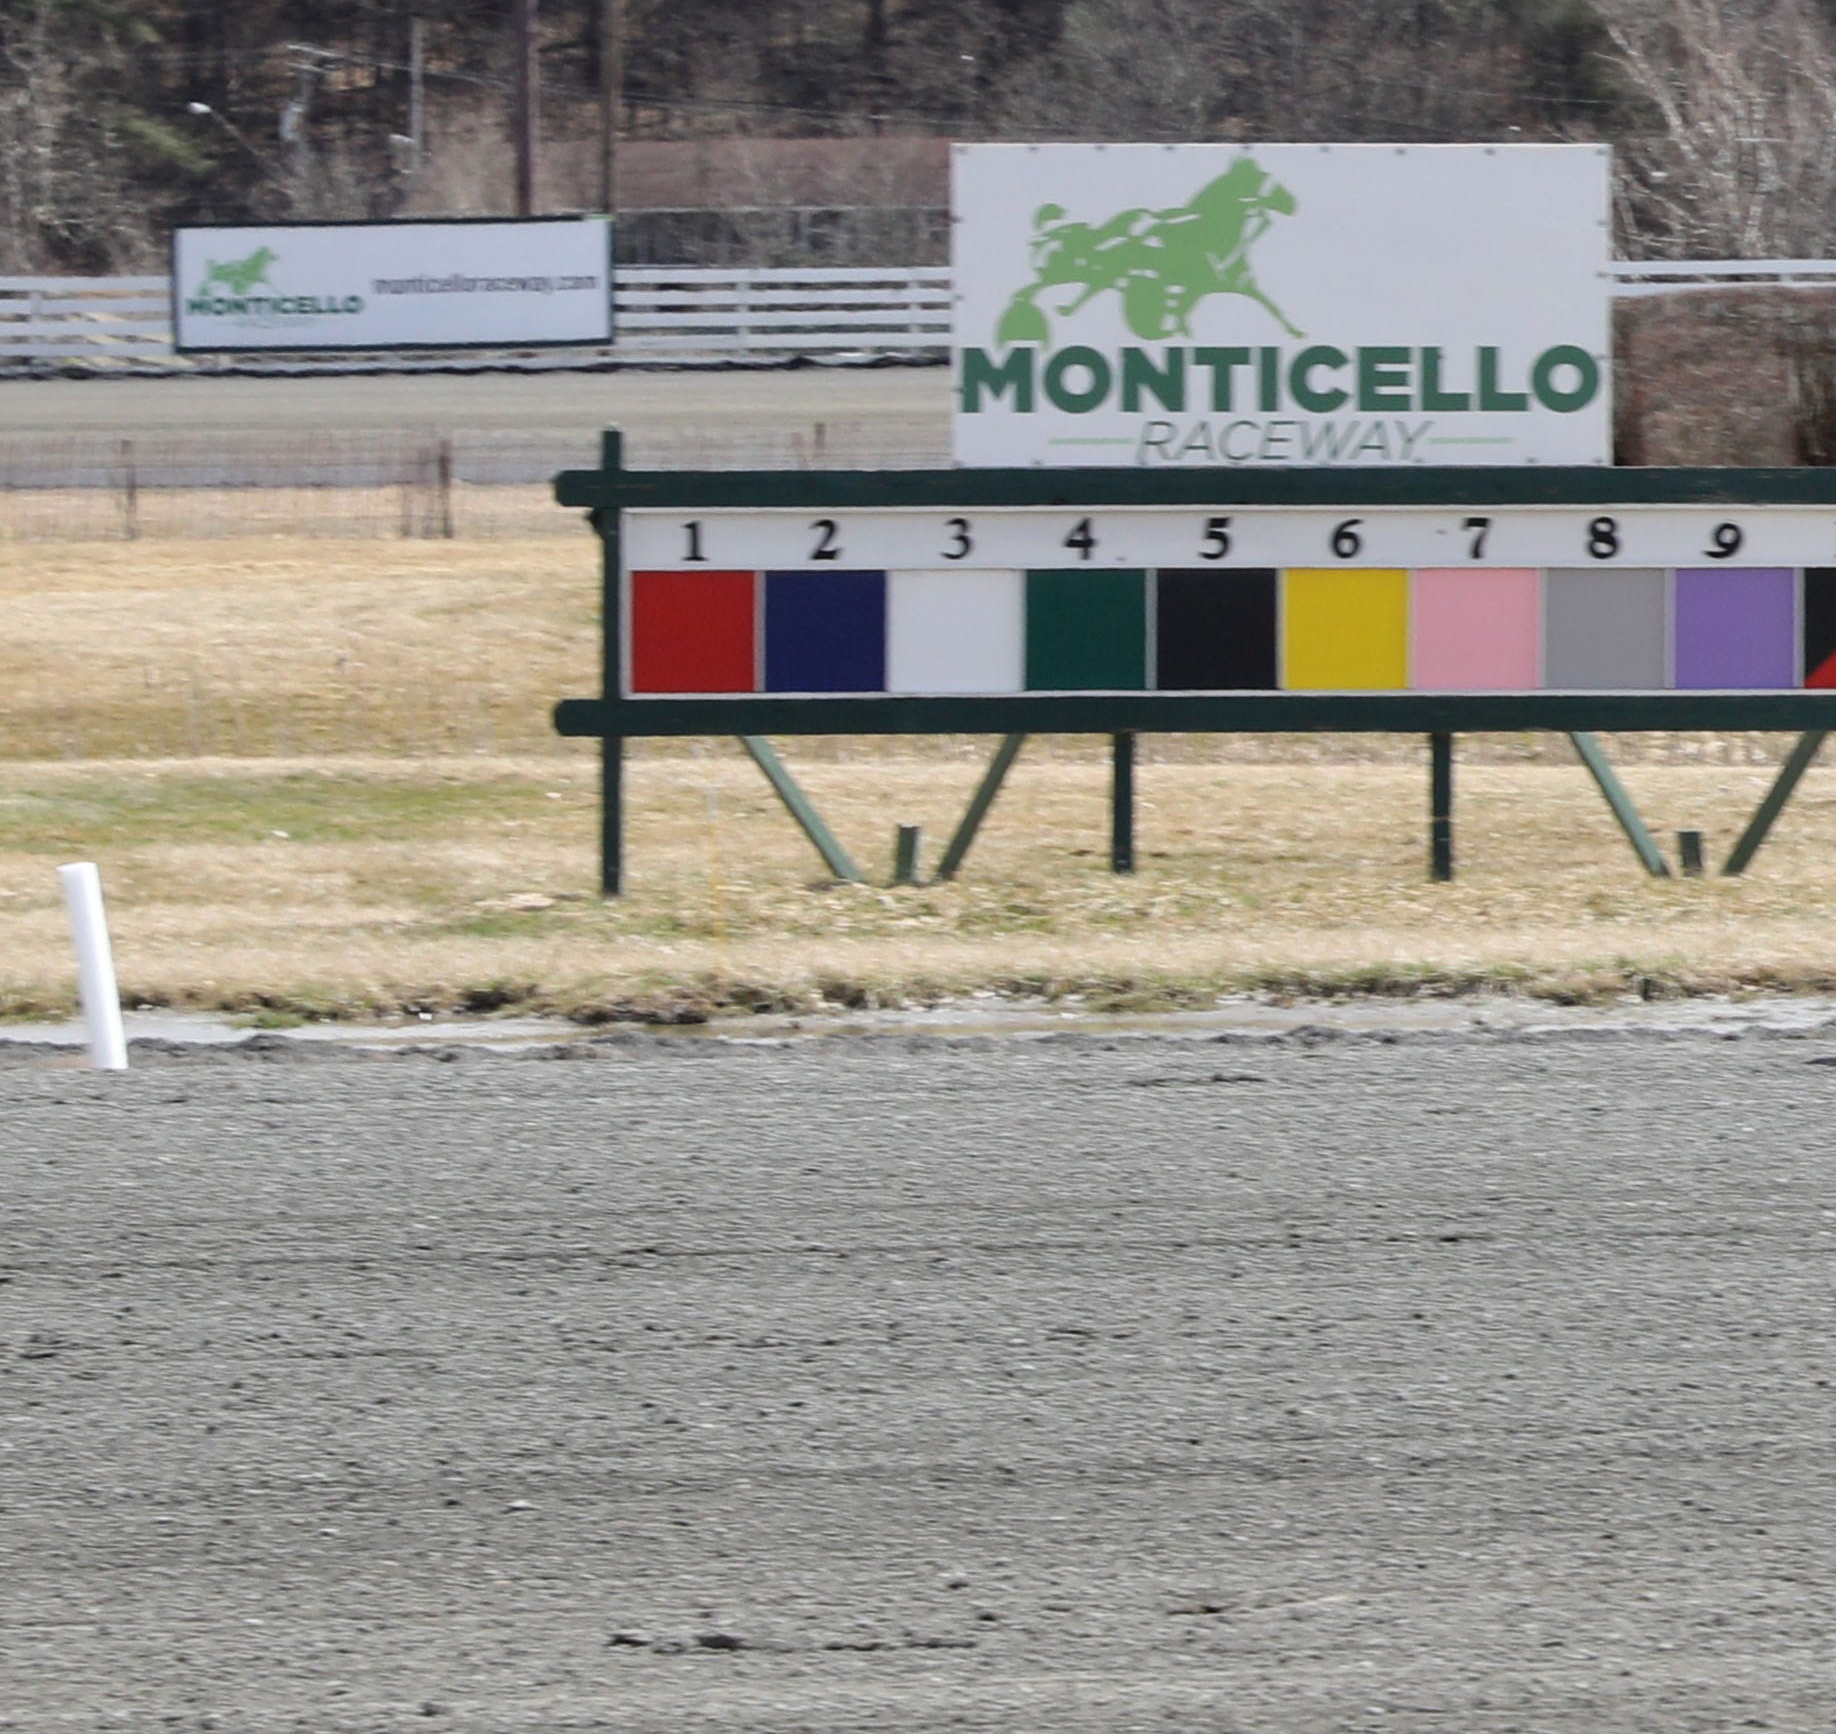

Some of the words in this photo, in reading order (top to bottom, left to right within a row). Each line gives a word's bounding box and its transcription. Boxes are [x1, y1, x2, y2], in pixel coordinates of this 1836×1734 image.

[960, 345, 1602, 413] MONTICELLO
[1133, 419, 1435, 463] RACEWAY
[683, 521, 707, 561] 1
[810, 519, 841, 560] 2
[942, 518, 973, 560] 3
[1063, 517, 1097, 560] 4
[1199, 517, 1233, 560] 5
[1330, 519, 1364, 559] 6
[1461, 517, 1491, 559] 7
[1586, 517, 1620, 560] 8
[1704, 522, 1743, 559] 9
